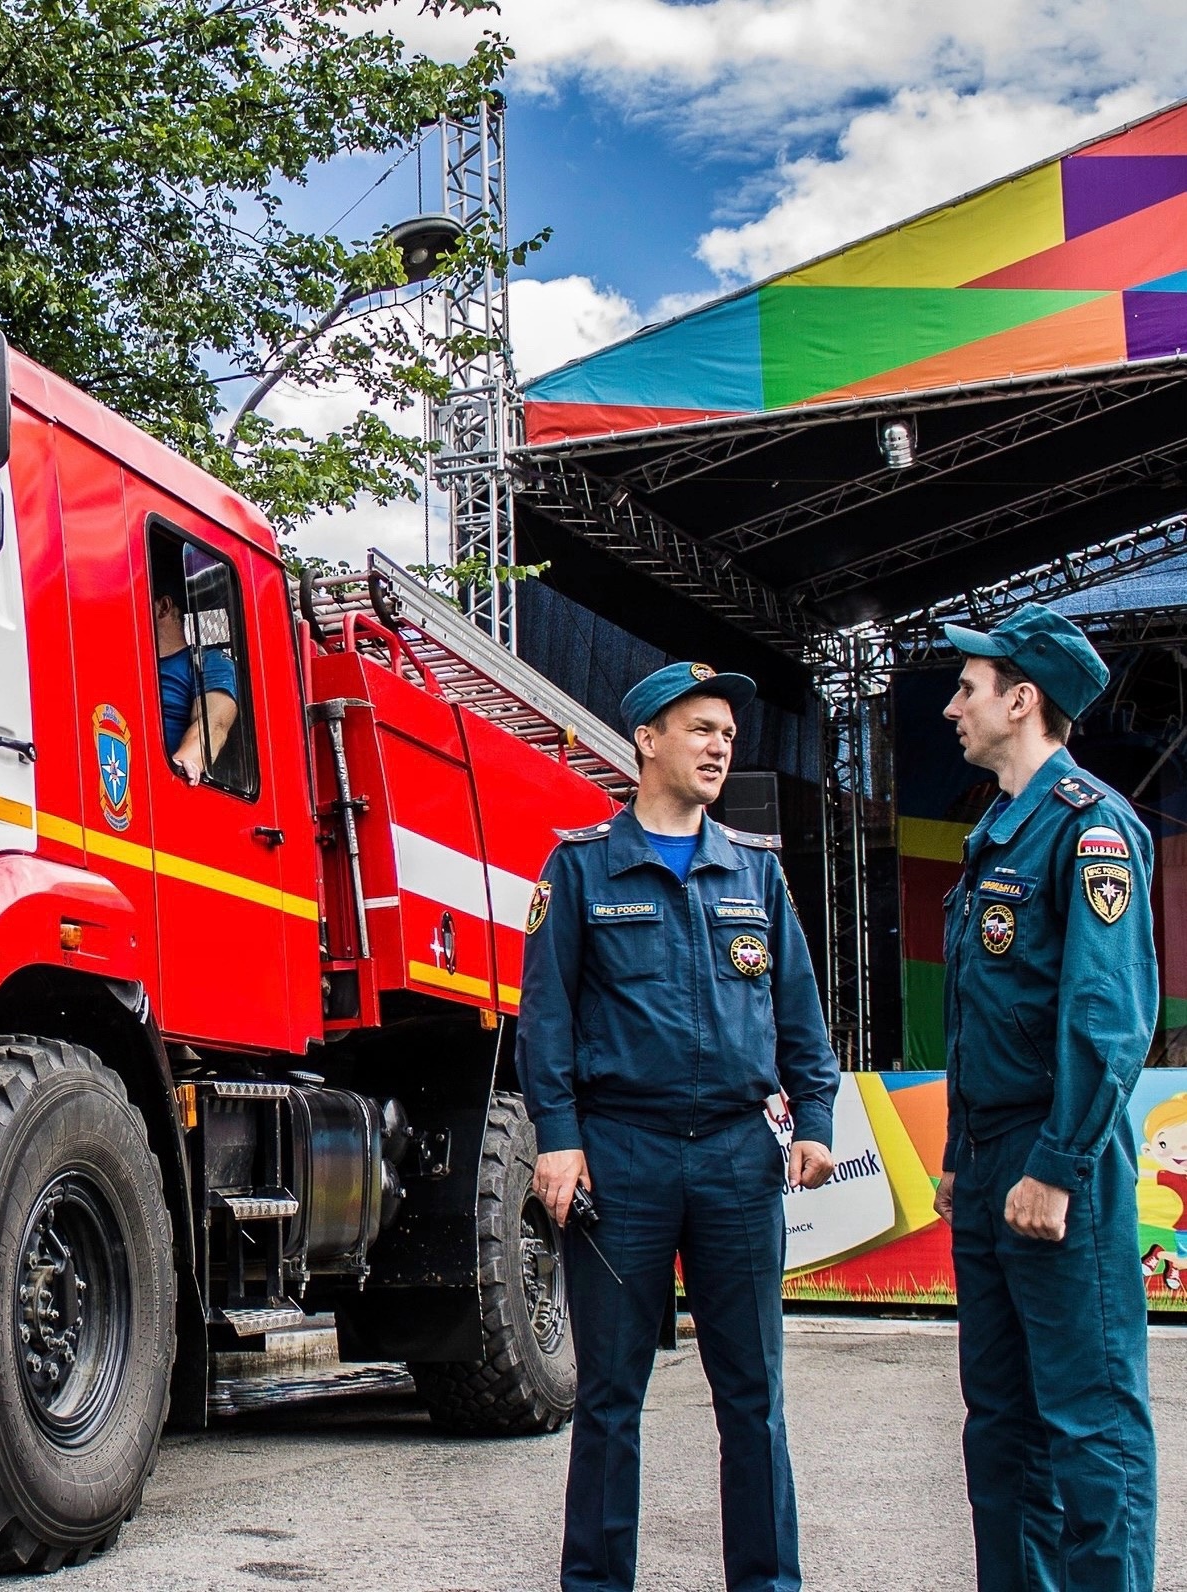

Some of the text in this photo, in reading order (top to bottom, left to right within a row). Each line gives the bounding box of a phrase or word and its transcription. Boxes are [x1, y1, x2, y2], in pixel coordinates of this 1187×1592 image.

[1085, 846, 1122, 855] RUSSIA
[595, 905, 654, 915] МЧС РОССИИ
[785, 1222, 814, 1235] ОМСК
